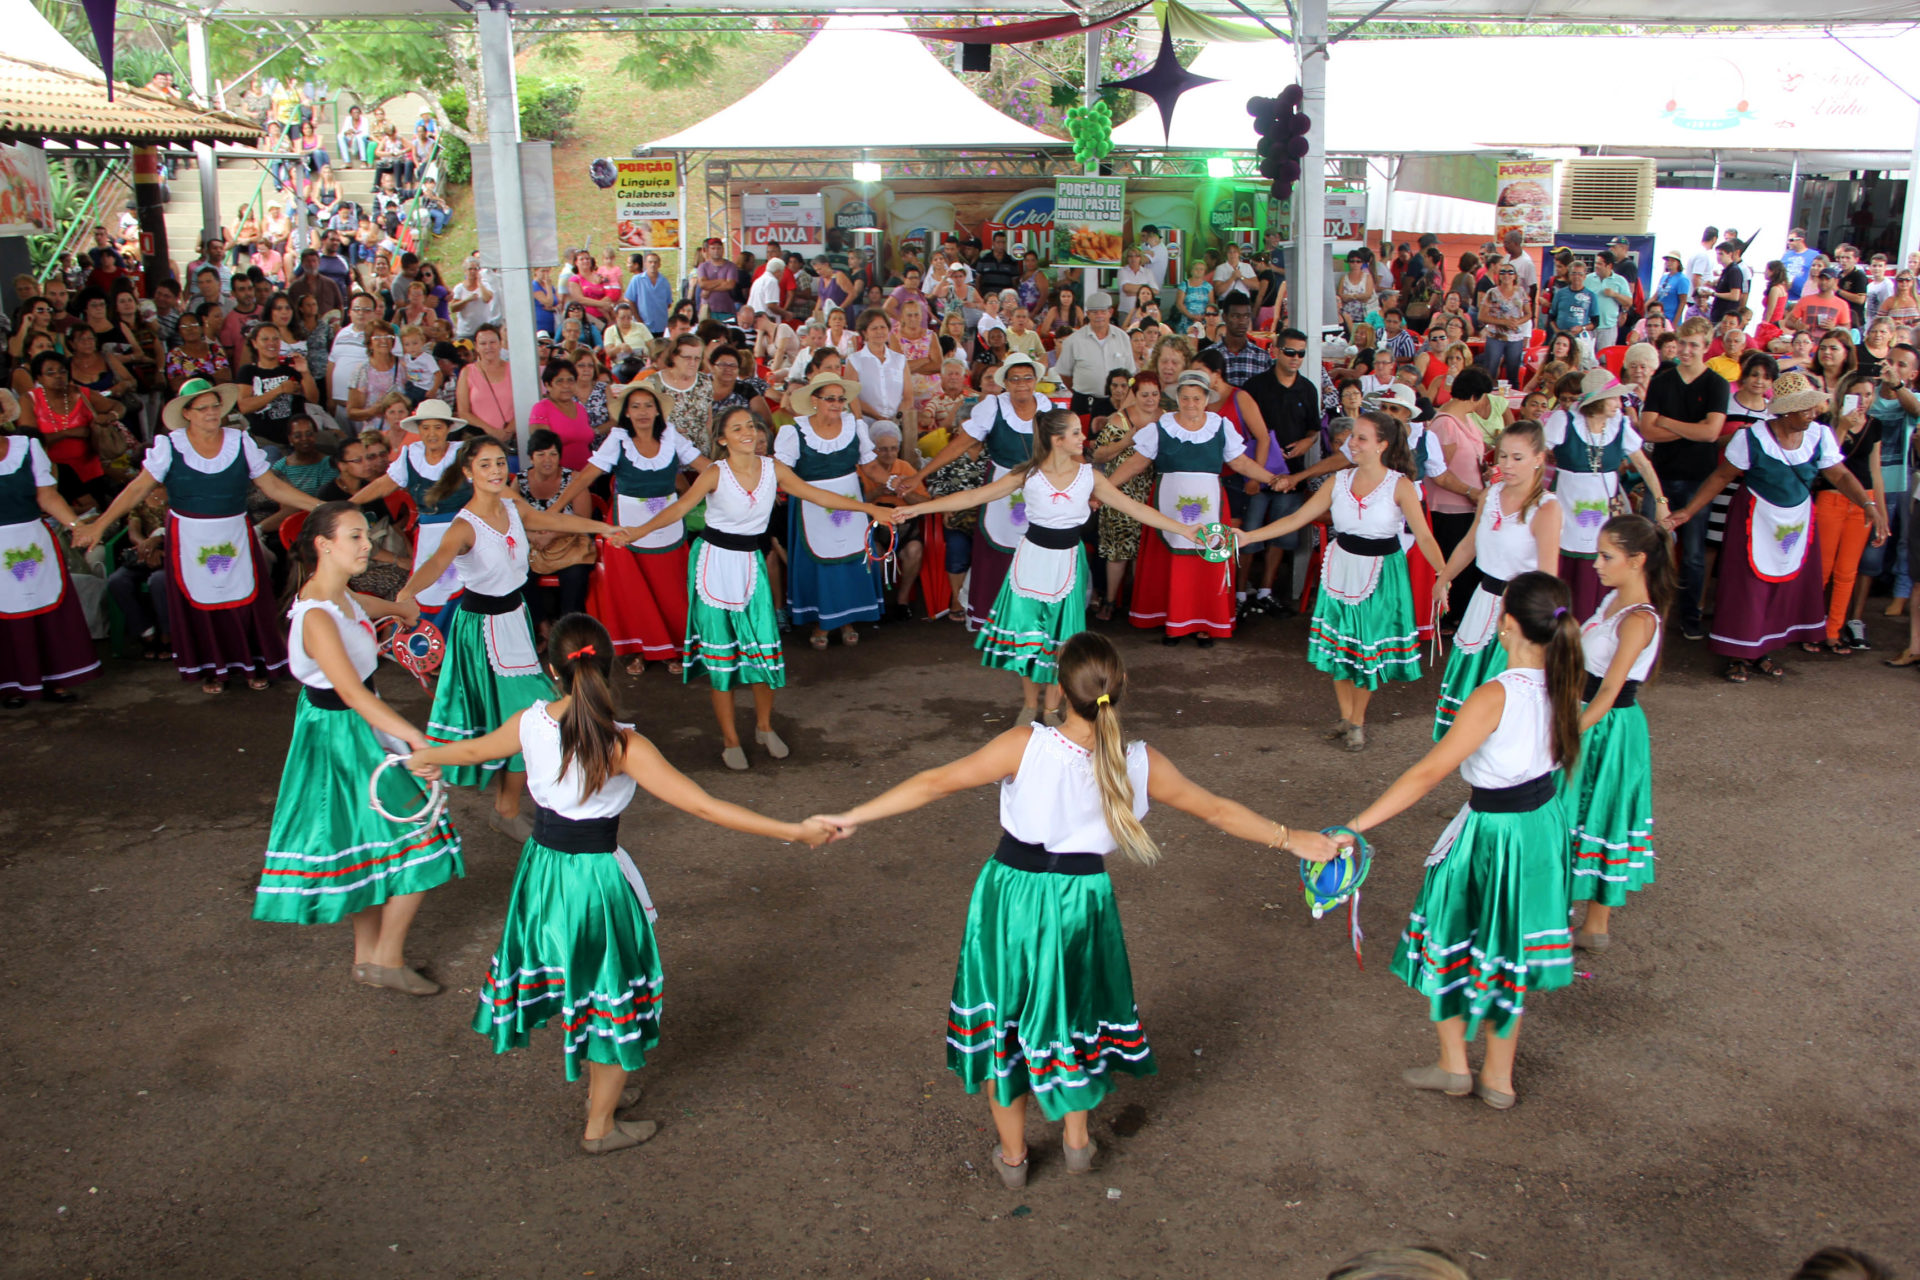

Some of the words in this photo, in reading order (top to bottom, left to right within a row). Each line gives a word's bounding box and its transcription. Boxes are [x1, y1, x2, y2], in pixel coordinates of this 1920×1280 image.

[618, 161, 673, 173] PORÇÃO
[621, 177, 670, 188] Linguiça
[1059, 181, 1105, 198] PORÇÃO
[1107, 184, 1121, 197] DE
[617, 190, 675, 199] Calabresa
[1058, 197, 1082, 210] MINI
[1085, 198, 1121, 211] PASTEL
[837, 212, 875, 228] BRAHMA
[1006, 208, 1055, 229] Chop
[1057, 210, 1084, 219] FRITOS
[1085, 211, 1096, 220] NA
[1211, 211, 1233, 225] BRAH
[755, 226, 808, 243] CAIXA
[1325, 221, 1353, 237] IXA
